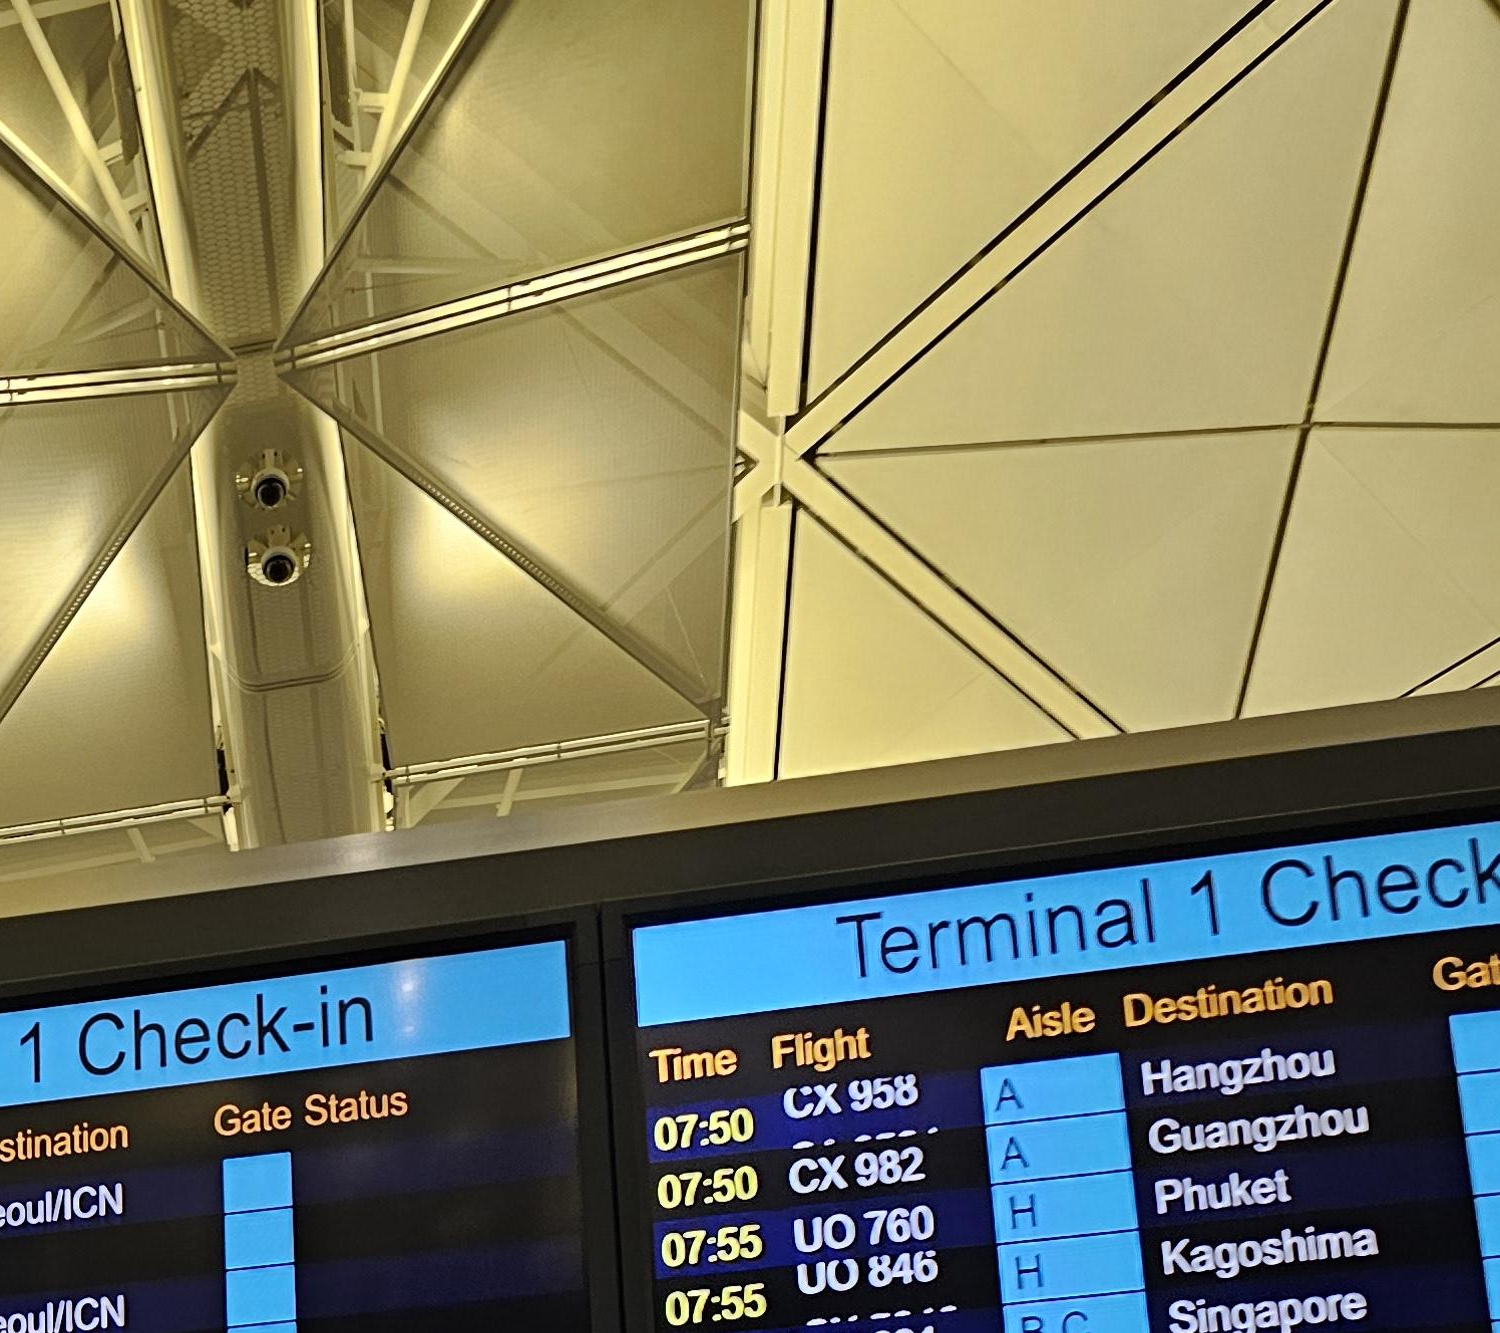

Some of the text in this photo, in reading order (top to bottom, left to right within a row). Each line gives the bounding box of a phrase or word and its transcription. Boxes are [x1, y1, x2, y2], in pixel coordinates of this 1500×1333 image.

[835, 877, 1156, 978] Terminal
[1190, 869, 1220, 936] 1
[20, 1021, 41, 1084] 1
[78, 984, 374, 1076] Check-in
[648, 976, 1334, 1083] Time Flight Aisle Destination
[214, 1101, 292, 1137] Gate
[304, 1090, 408, 1126] Status
[657, 1104, 1370, 1209] 07:50 CX 982 A Guangzhou
[661, 1168, 1292, 1268] 07:55 UO 760 H Phuket
